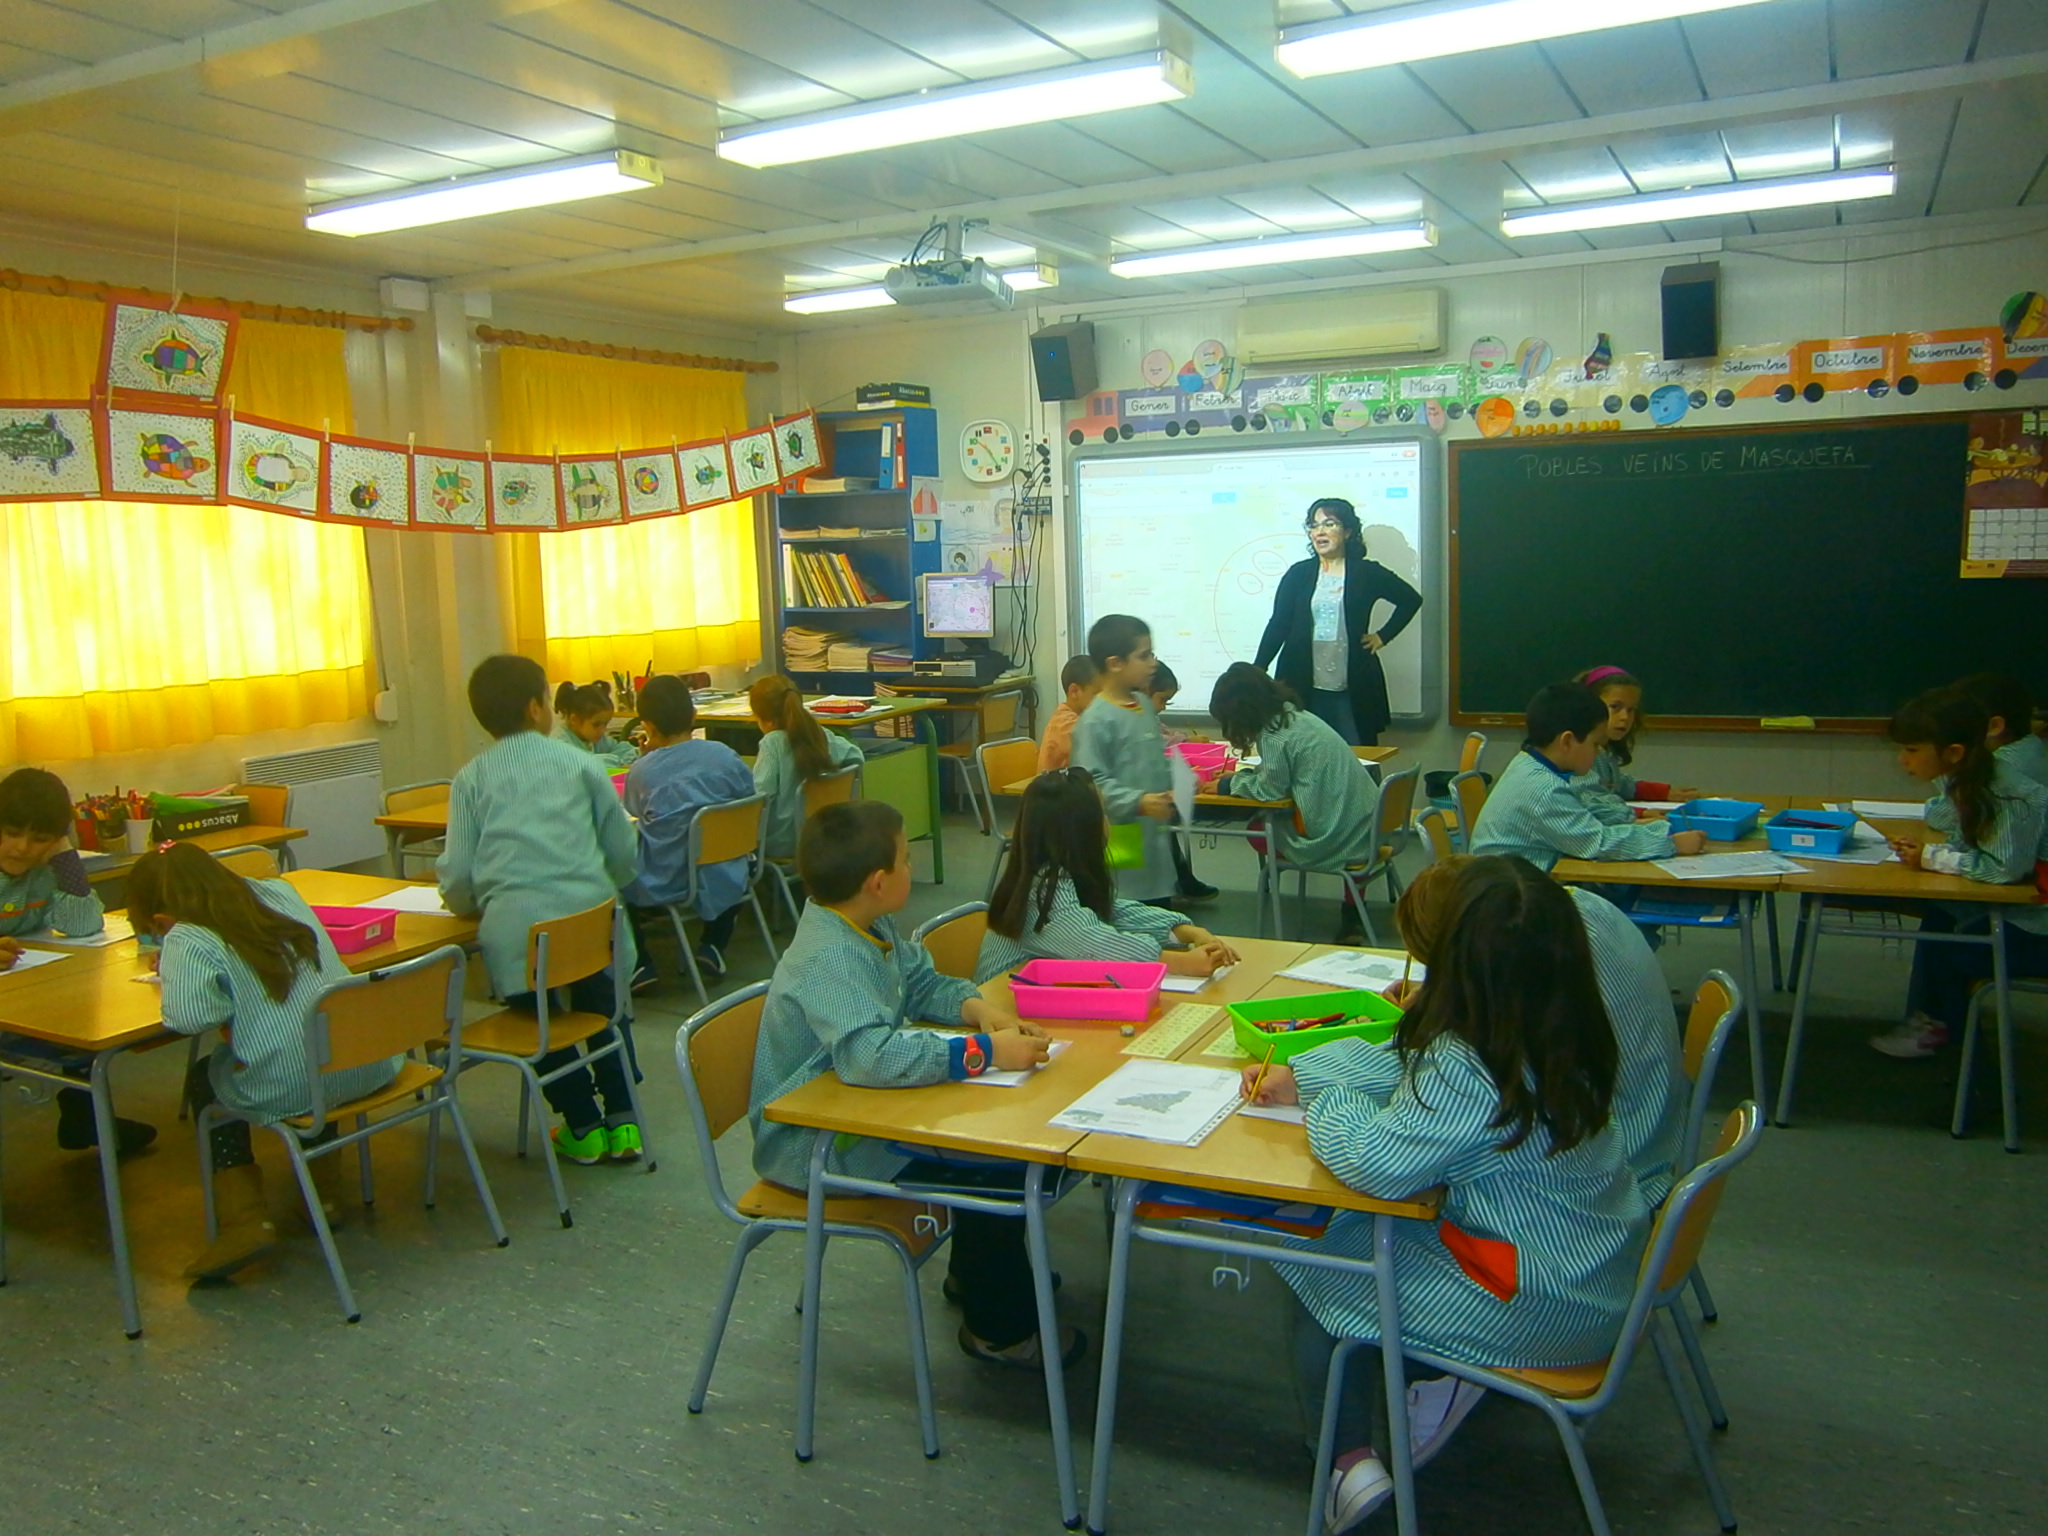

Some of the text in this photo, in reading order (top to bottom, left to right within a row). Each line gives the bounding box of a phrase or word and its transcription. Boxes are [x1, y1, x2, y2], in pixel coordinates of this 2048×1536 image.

[1908, 342, 1983, 360] Novembre
[1723, 358, 1788, 374] Setembre
[1814, 352, 1880, 369] Octubre
[1563, 369, 1610, 383] Juol
[1649, 364, 1687, 386] Agost
[1338, 384, 1376, 397] Abril
[1409, 379, 1448, 397] Maig
[1131, 400, 1170, 412] Gener
[1514, 454, 1602, 478] POBLES
[1702, 451, 1724, 472] DE
[1740, 445, 1855, 468] MASQUEFA
[202, 814, 239, 827] Abacus
